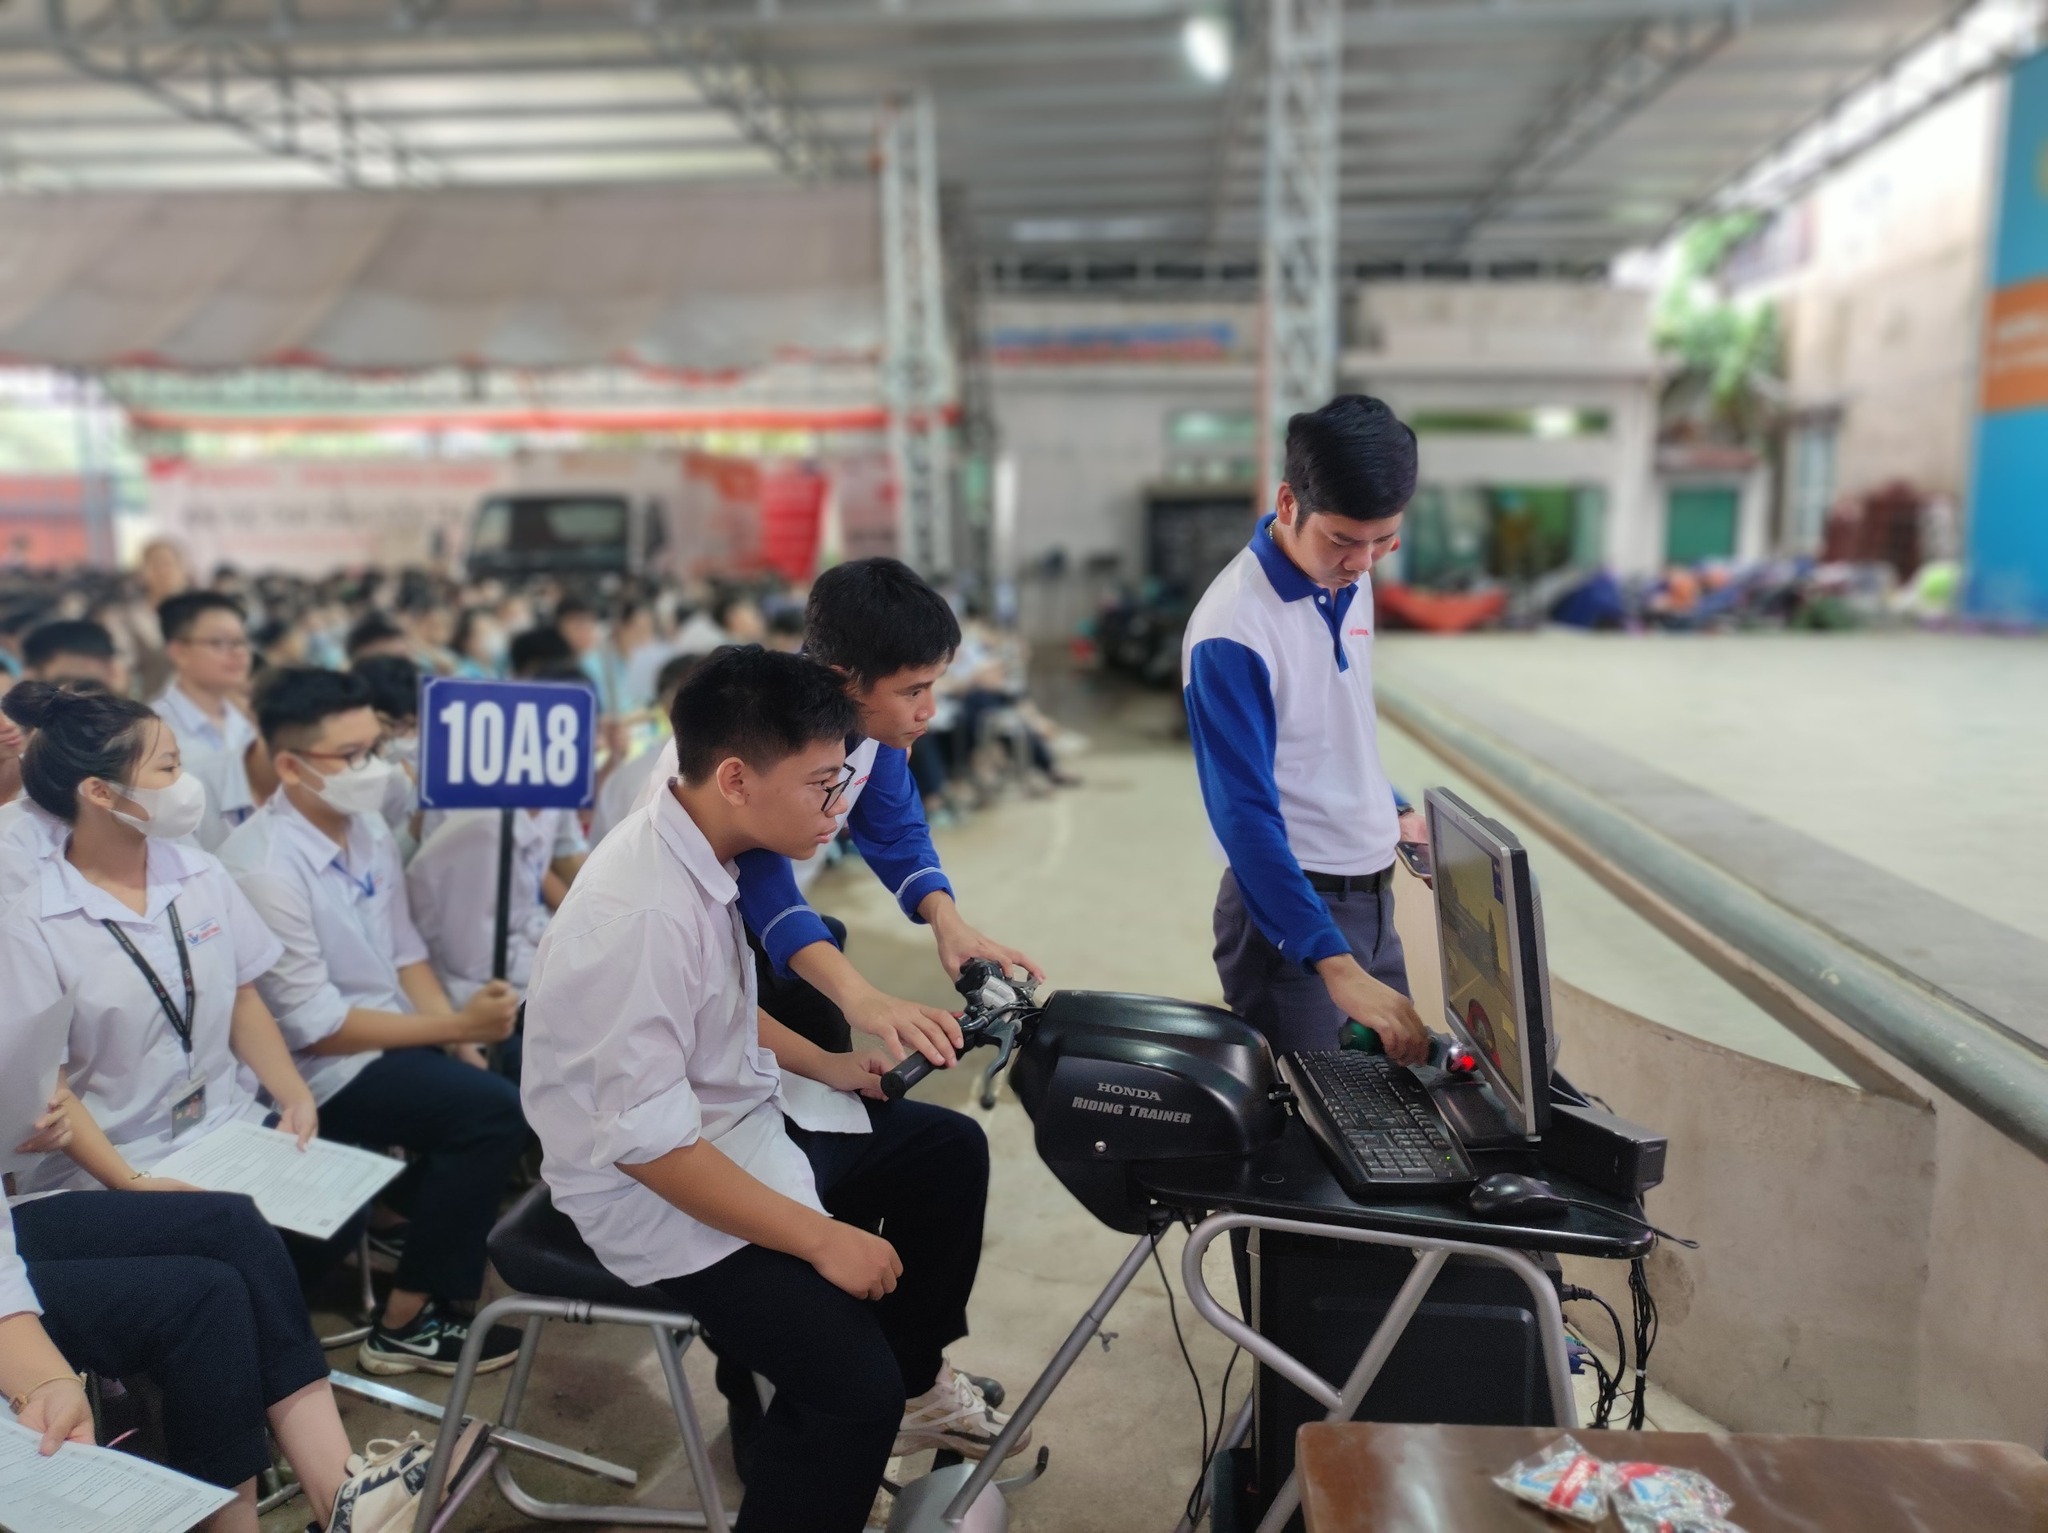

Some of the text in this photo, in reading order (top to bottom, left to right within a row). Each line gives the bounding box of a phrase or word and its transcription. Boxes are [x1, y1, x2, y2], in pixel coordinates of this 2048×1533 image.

[440, 701, 579, 787] 10A8
[1097, 1082, 1161, 1100] HONDA
[1072, 1096, 1191, 1123] RIDING TRAINER
